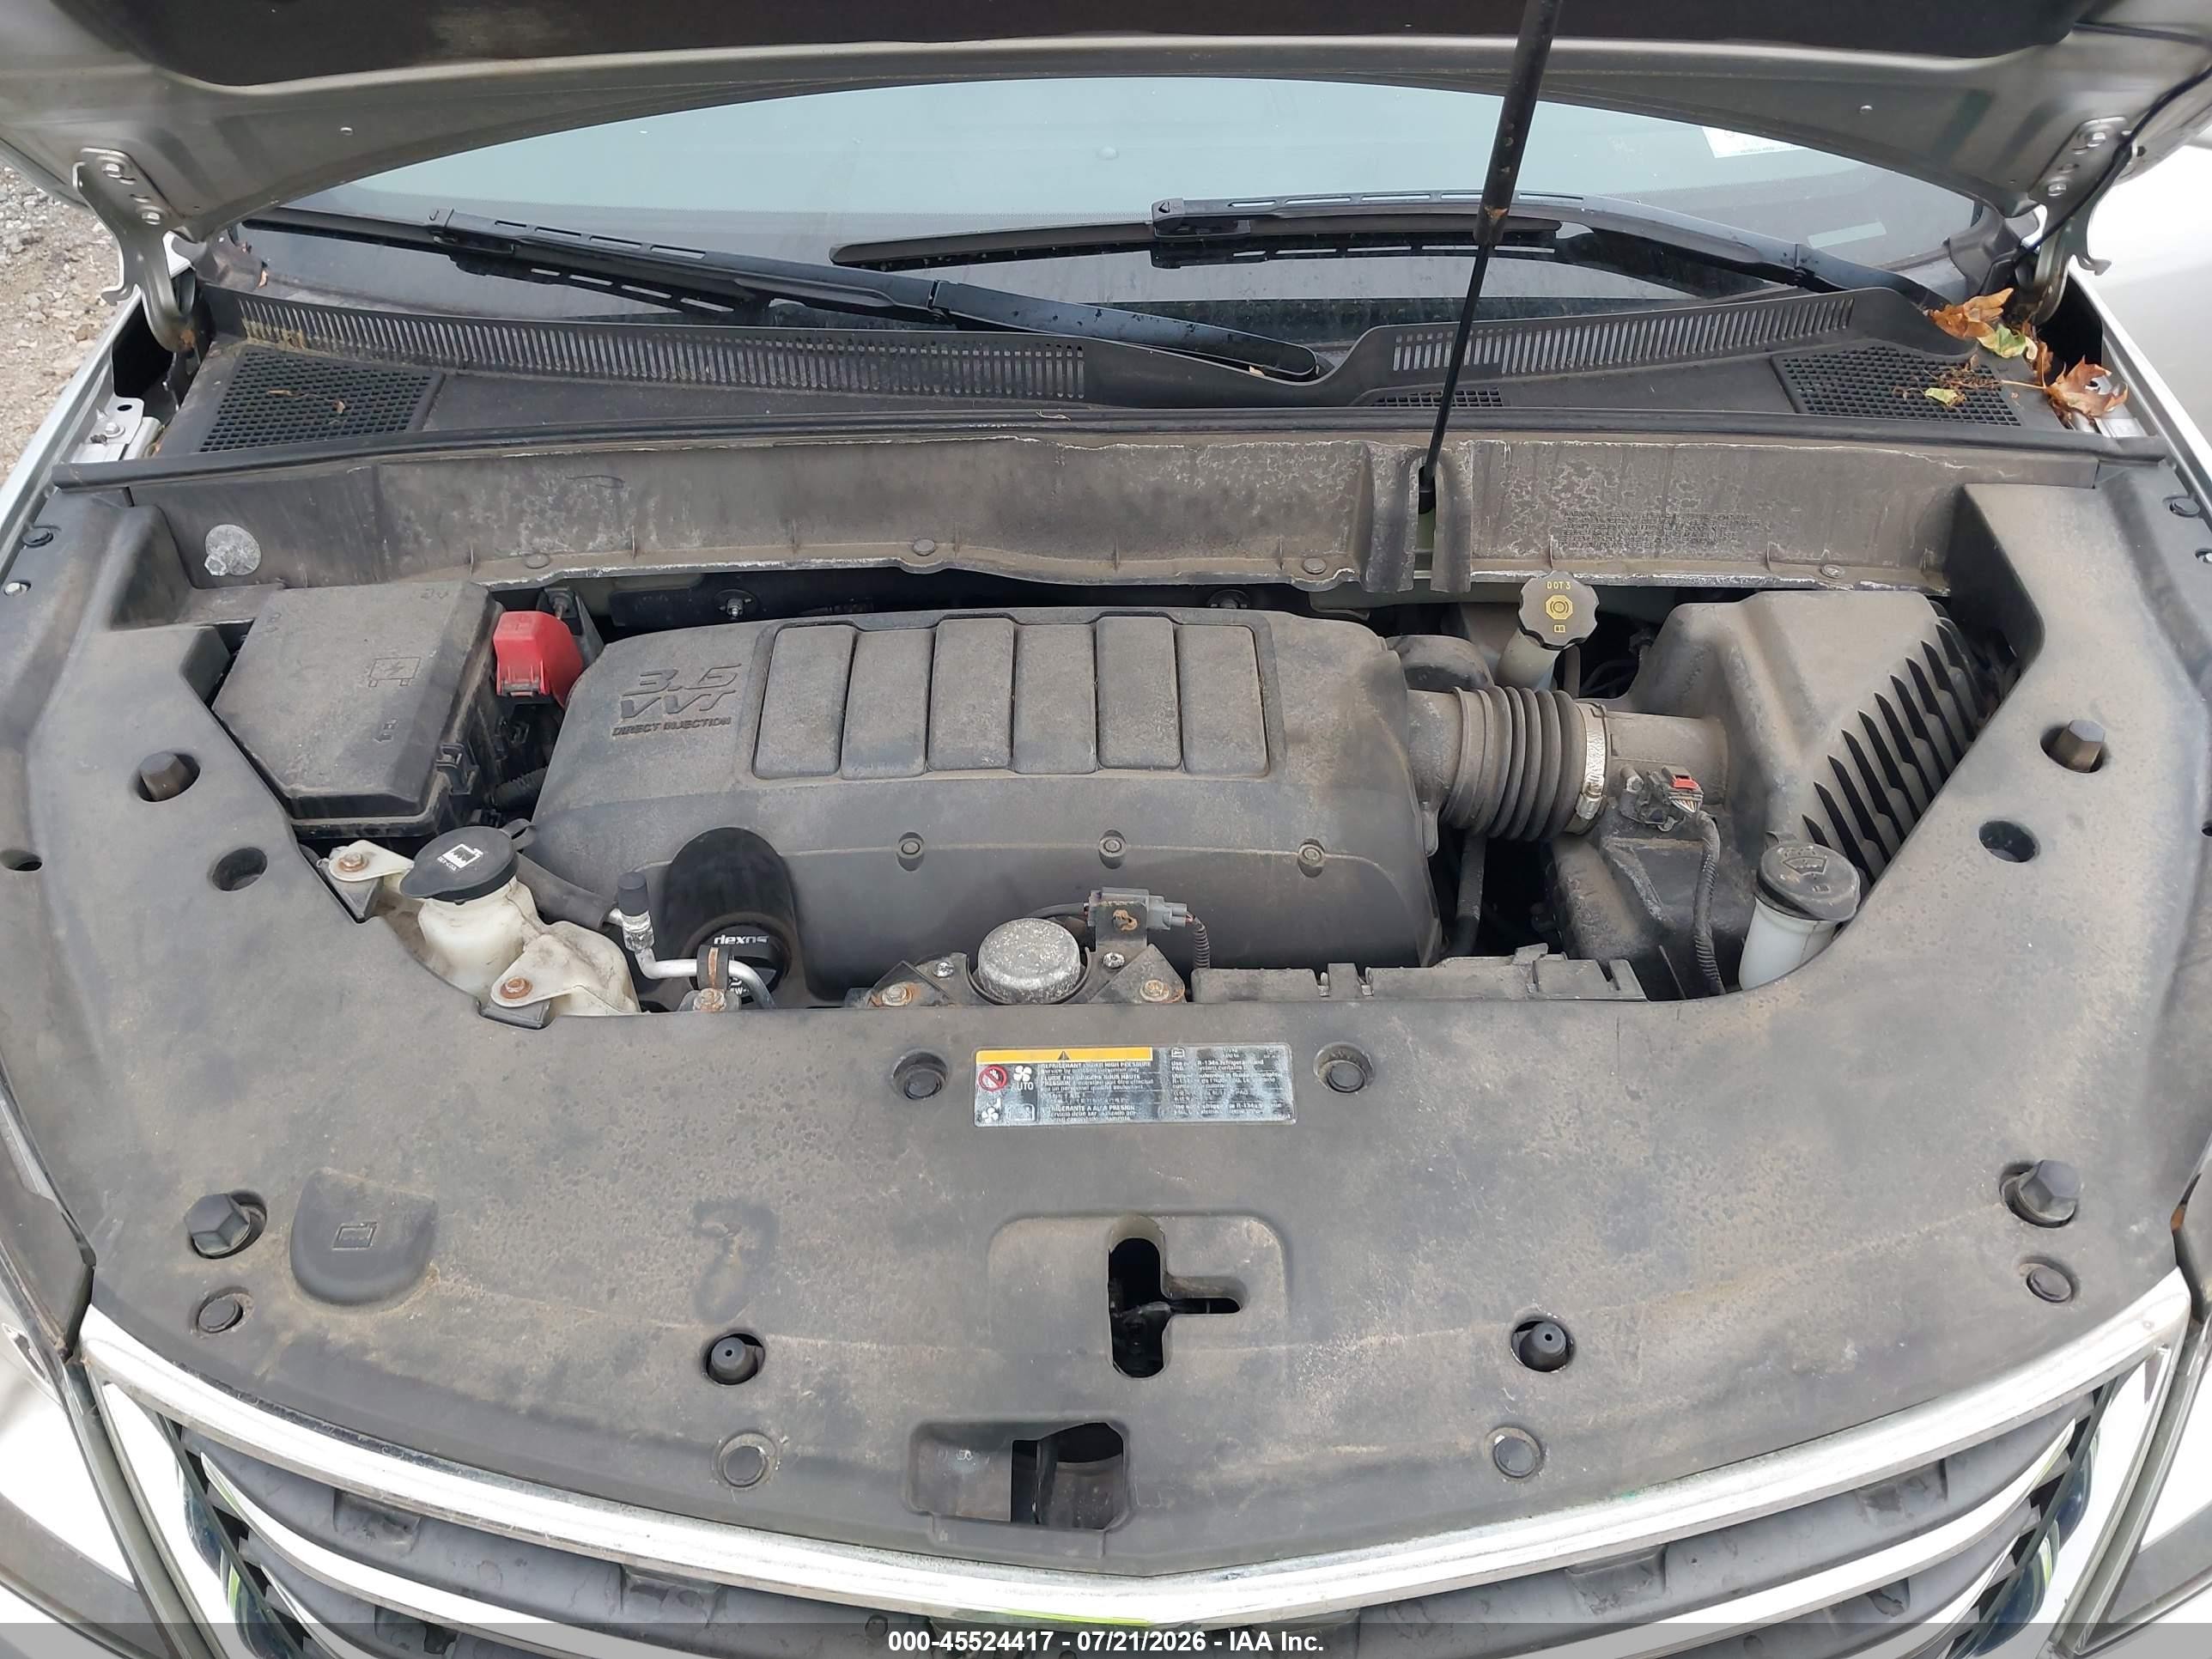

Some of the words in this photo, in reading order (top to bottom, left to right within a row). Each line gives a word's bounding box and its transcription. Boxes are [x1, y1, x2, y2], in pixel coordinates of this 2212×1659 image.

[1547, 580, 1564, 589] DOT
[1566, 580, 1571, 590] 3
[620, 690, 737, 719] VVT
[611, 722, 661, 736] DIRECT
[663, 716, 732, 730] INJECTION
